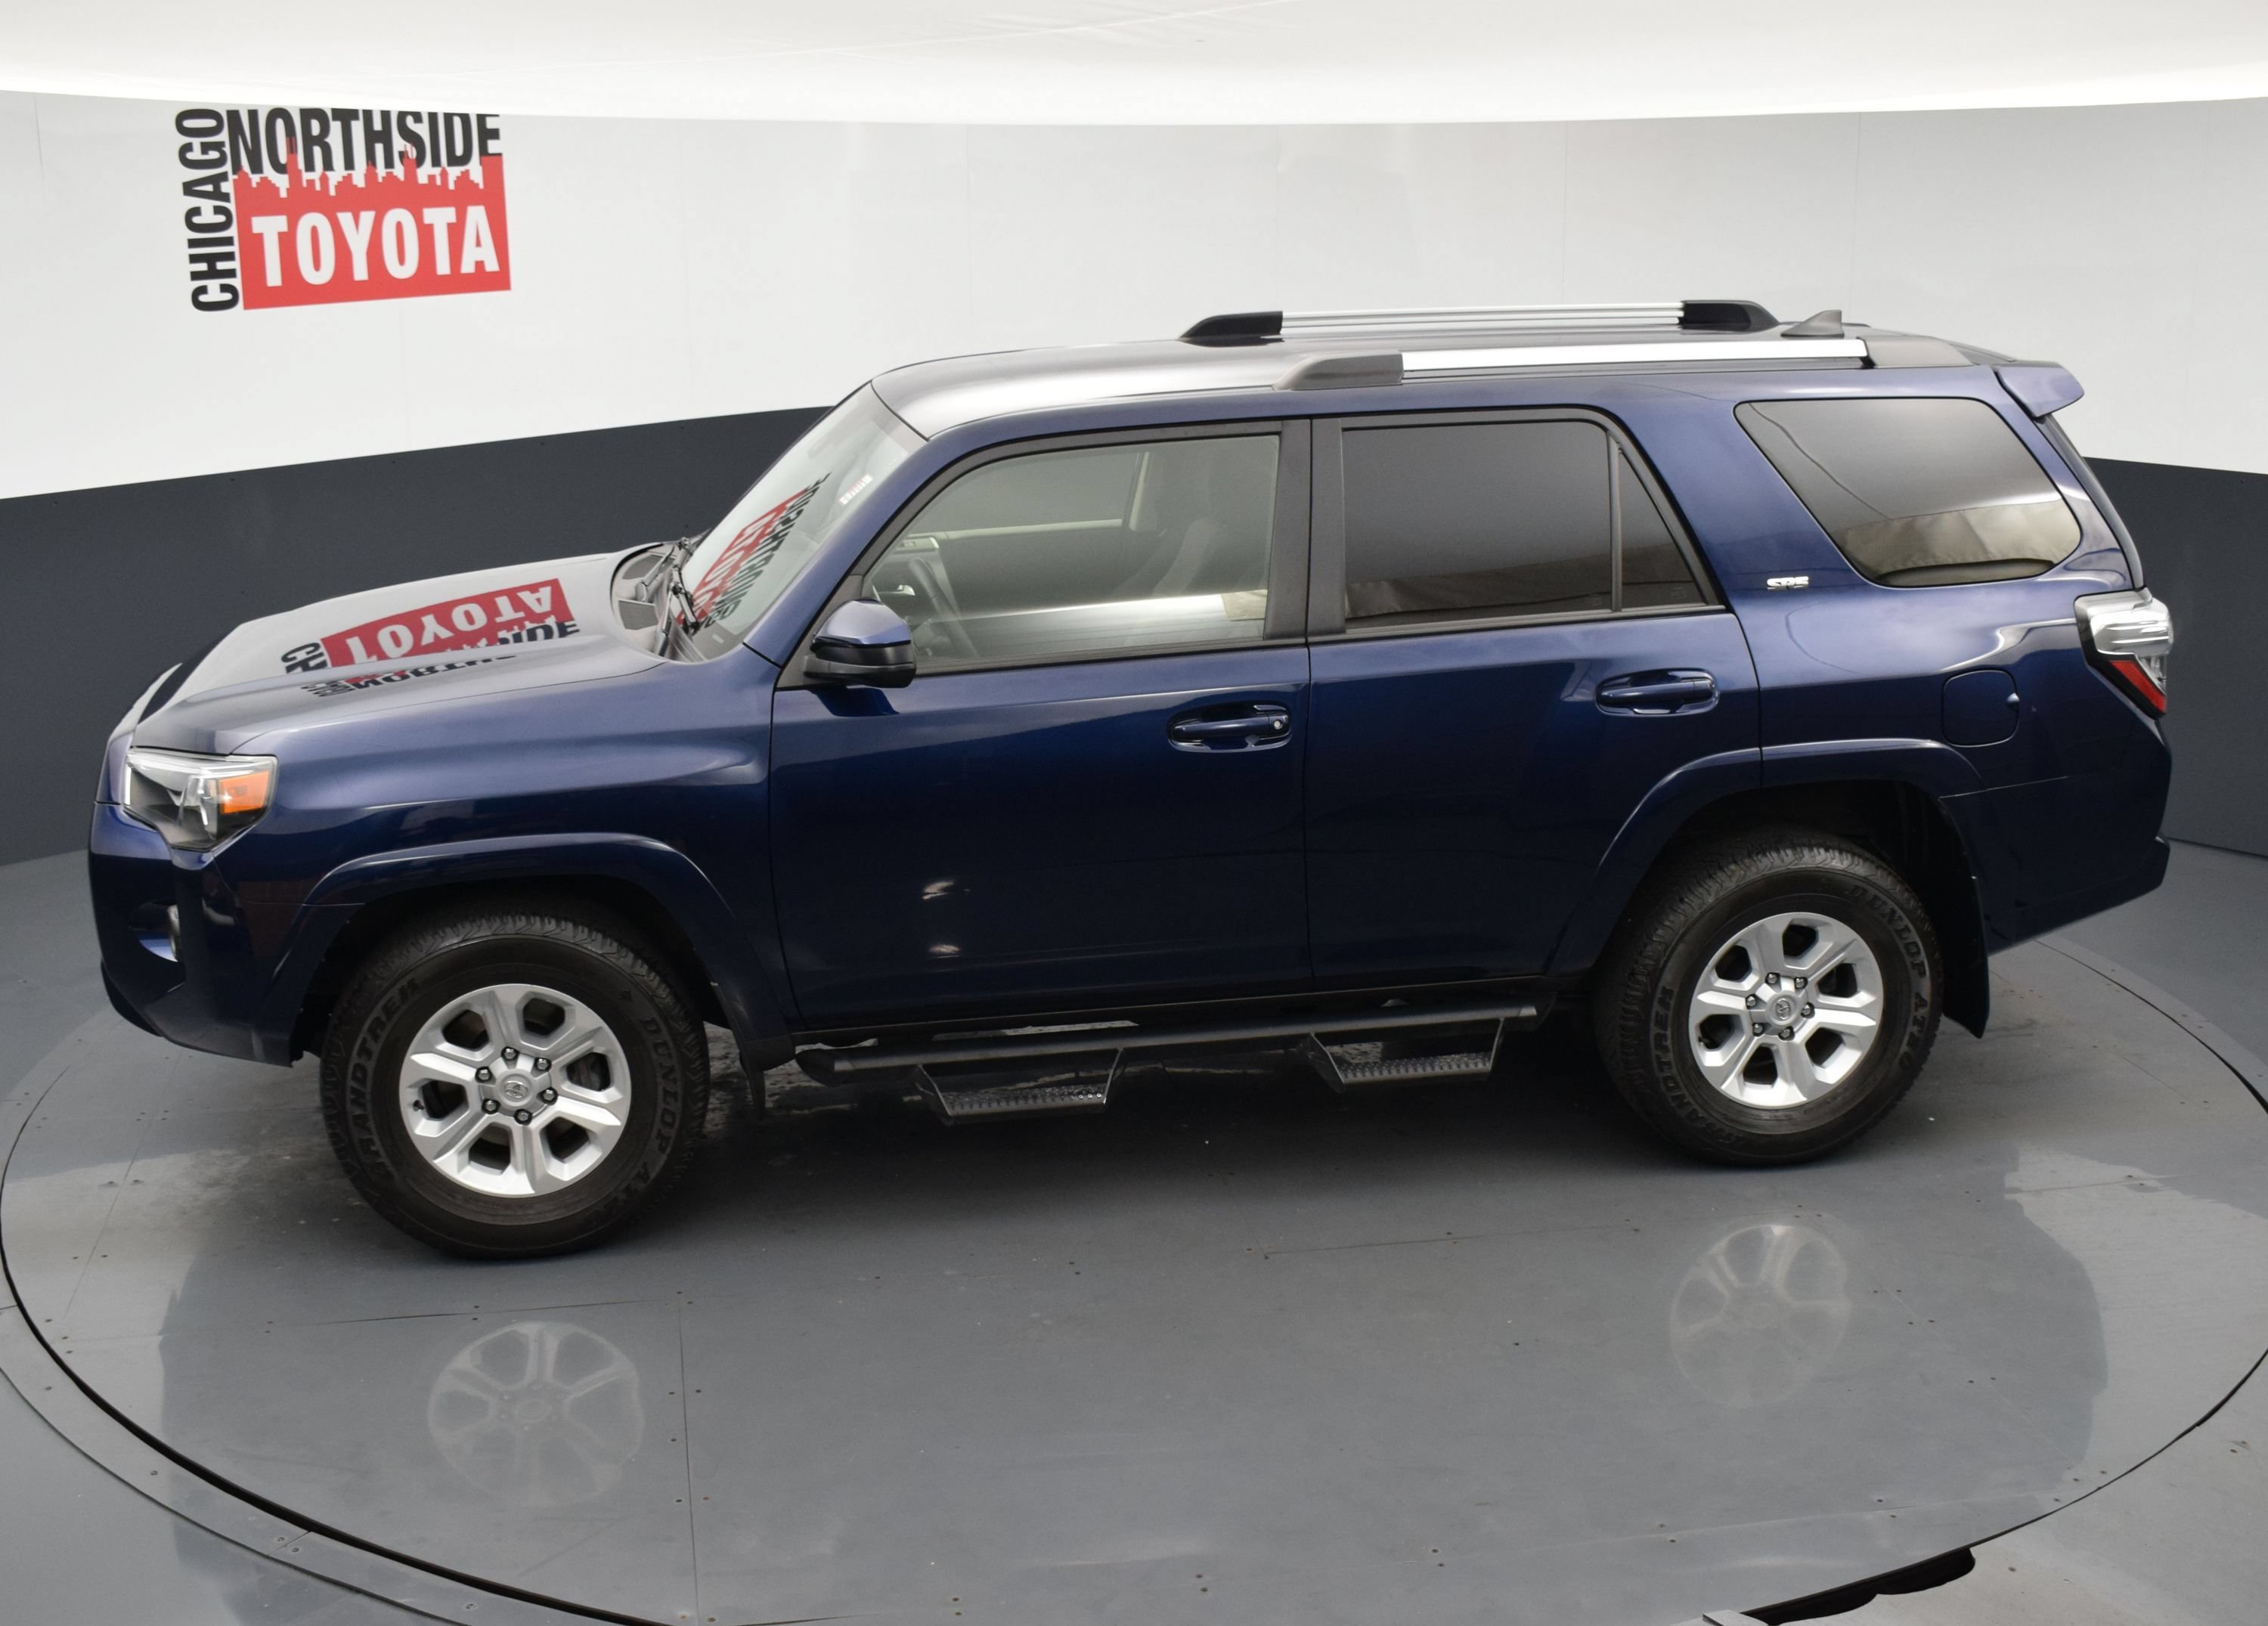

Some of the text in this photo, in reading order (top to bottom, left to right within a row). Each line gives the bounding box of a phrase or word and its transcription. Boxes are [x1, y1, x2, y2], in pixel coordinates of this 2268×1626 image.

[226, 107, 503, 175] NORTHSIDE
[175, 107, 240, 312] CHICAGO
[251, 205, 500, 287] TOYOTA
[639, 1017, 678, 1154] DUNLOP
